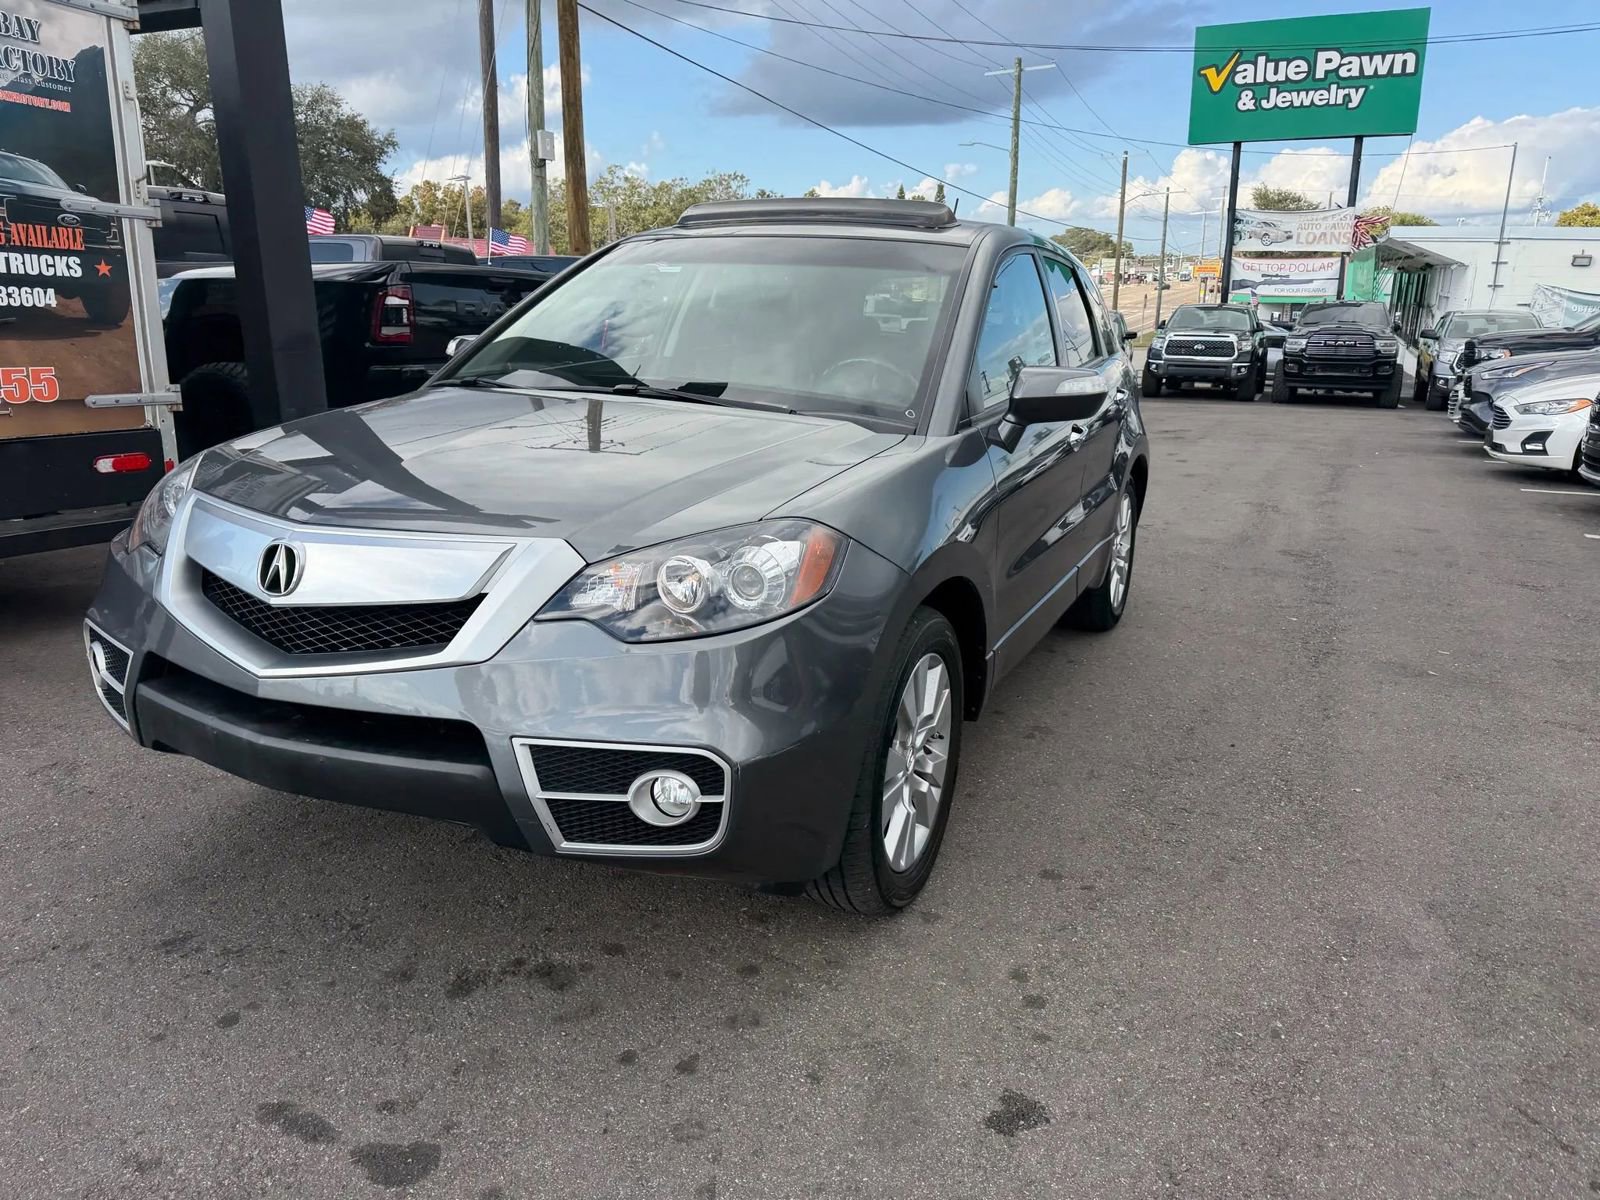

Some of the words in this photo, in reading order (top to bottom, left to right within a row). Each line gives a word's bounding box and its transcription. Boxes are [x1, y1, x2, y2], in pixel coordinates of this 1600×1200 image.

[1315, 50, 1417, 80] Pawn
[1236, 90, 1256, 111] &
[1261, 84, 1366, 109] Jewelry
[10, 222, 86, 251] AVAILABLE
[1296, 231, 1352, 246] LOANS
[1297, 222, 1321, 231] AUTO
[0, 251, 83, 278] TRUCKS
[1242, 263, 1264, 272] GET
[1266, 263, 1287, 272] TOP
[1289, 261, 1335, 273] DOLLAR
[0, 366, 60, 404] 55
